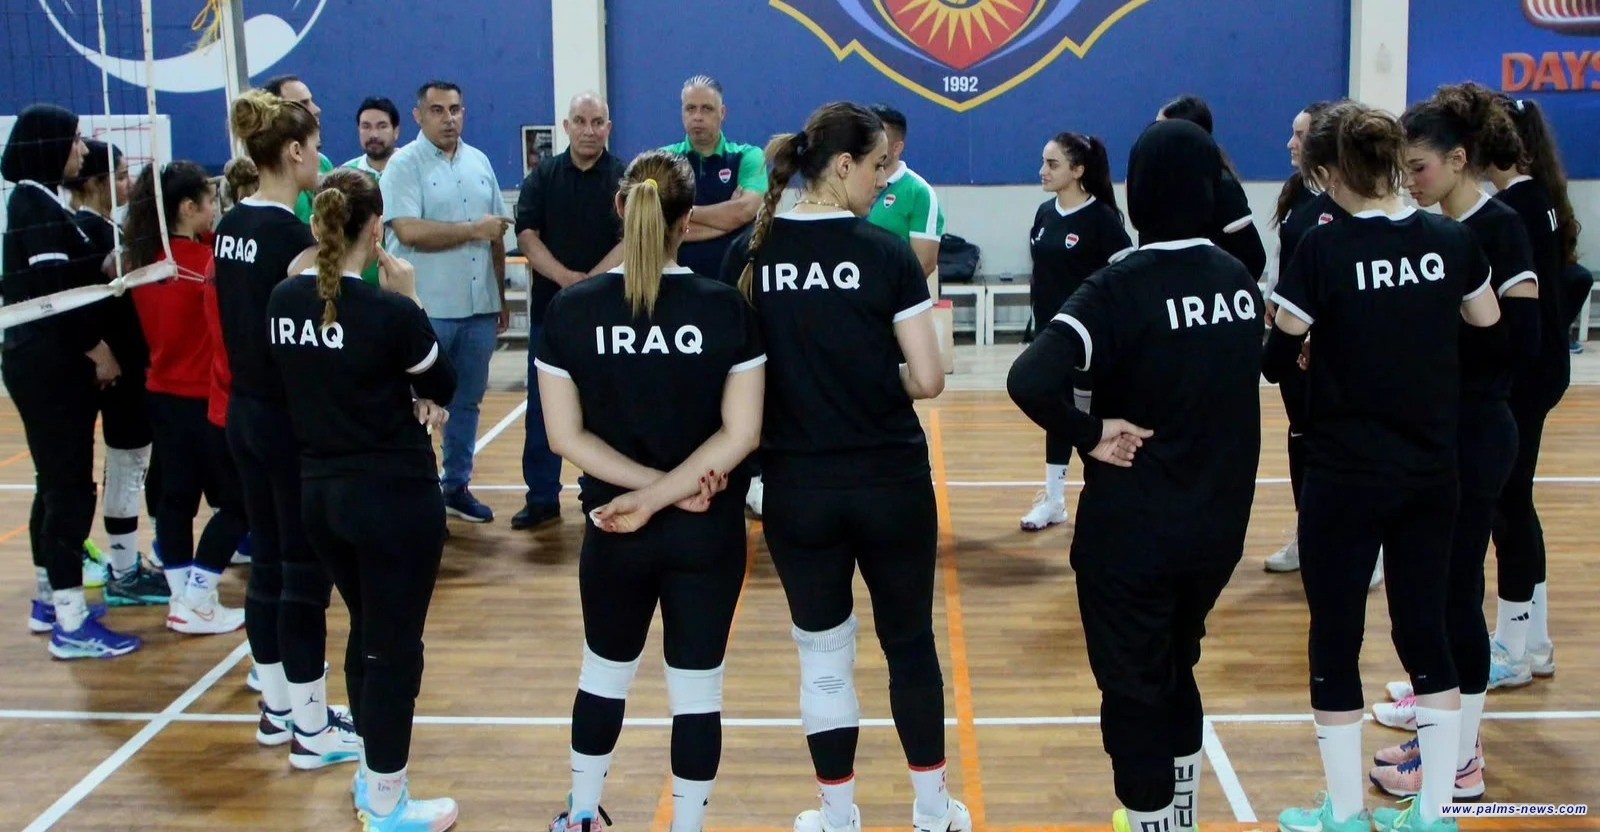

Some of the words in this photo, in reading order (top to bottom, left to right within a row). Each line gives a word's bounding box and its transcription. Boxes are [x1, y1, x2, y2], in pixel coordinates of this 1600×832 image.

[942, 76, 978, 92] 1992
[214, 234, 258, 264] IRAQ
[762, 261, 861, 292] IRAQ
[1355, 253, 1446, 291] IRAQ
[1166, 289, 1256, 330] IRAQ
[270, 317, 344, 350] IRAQ
[595, 324, 703, 355] IRAQ
